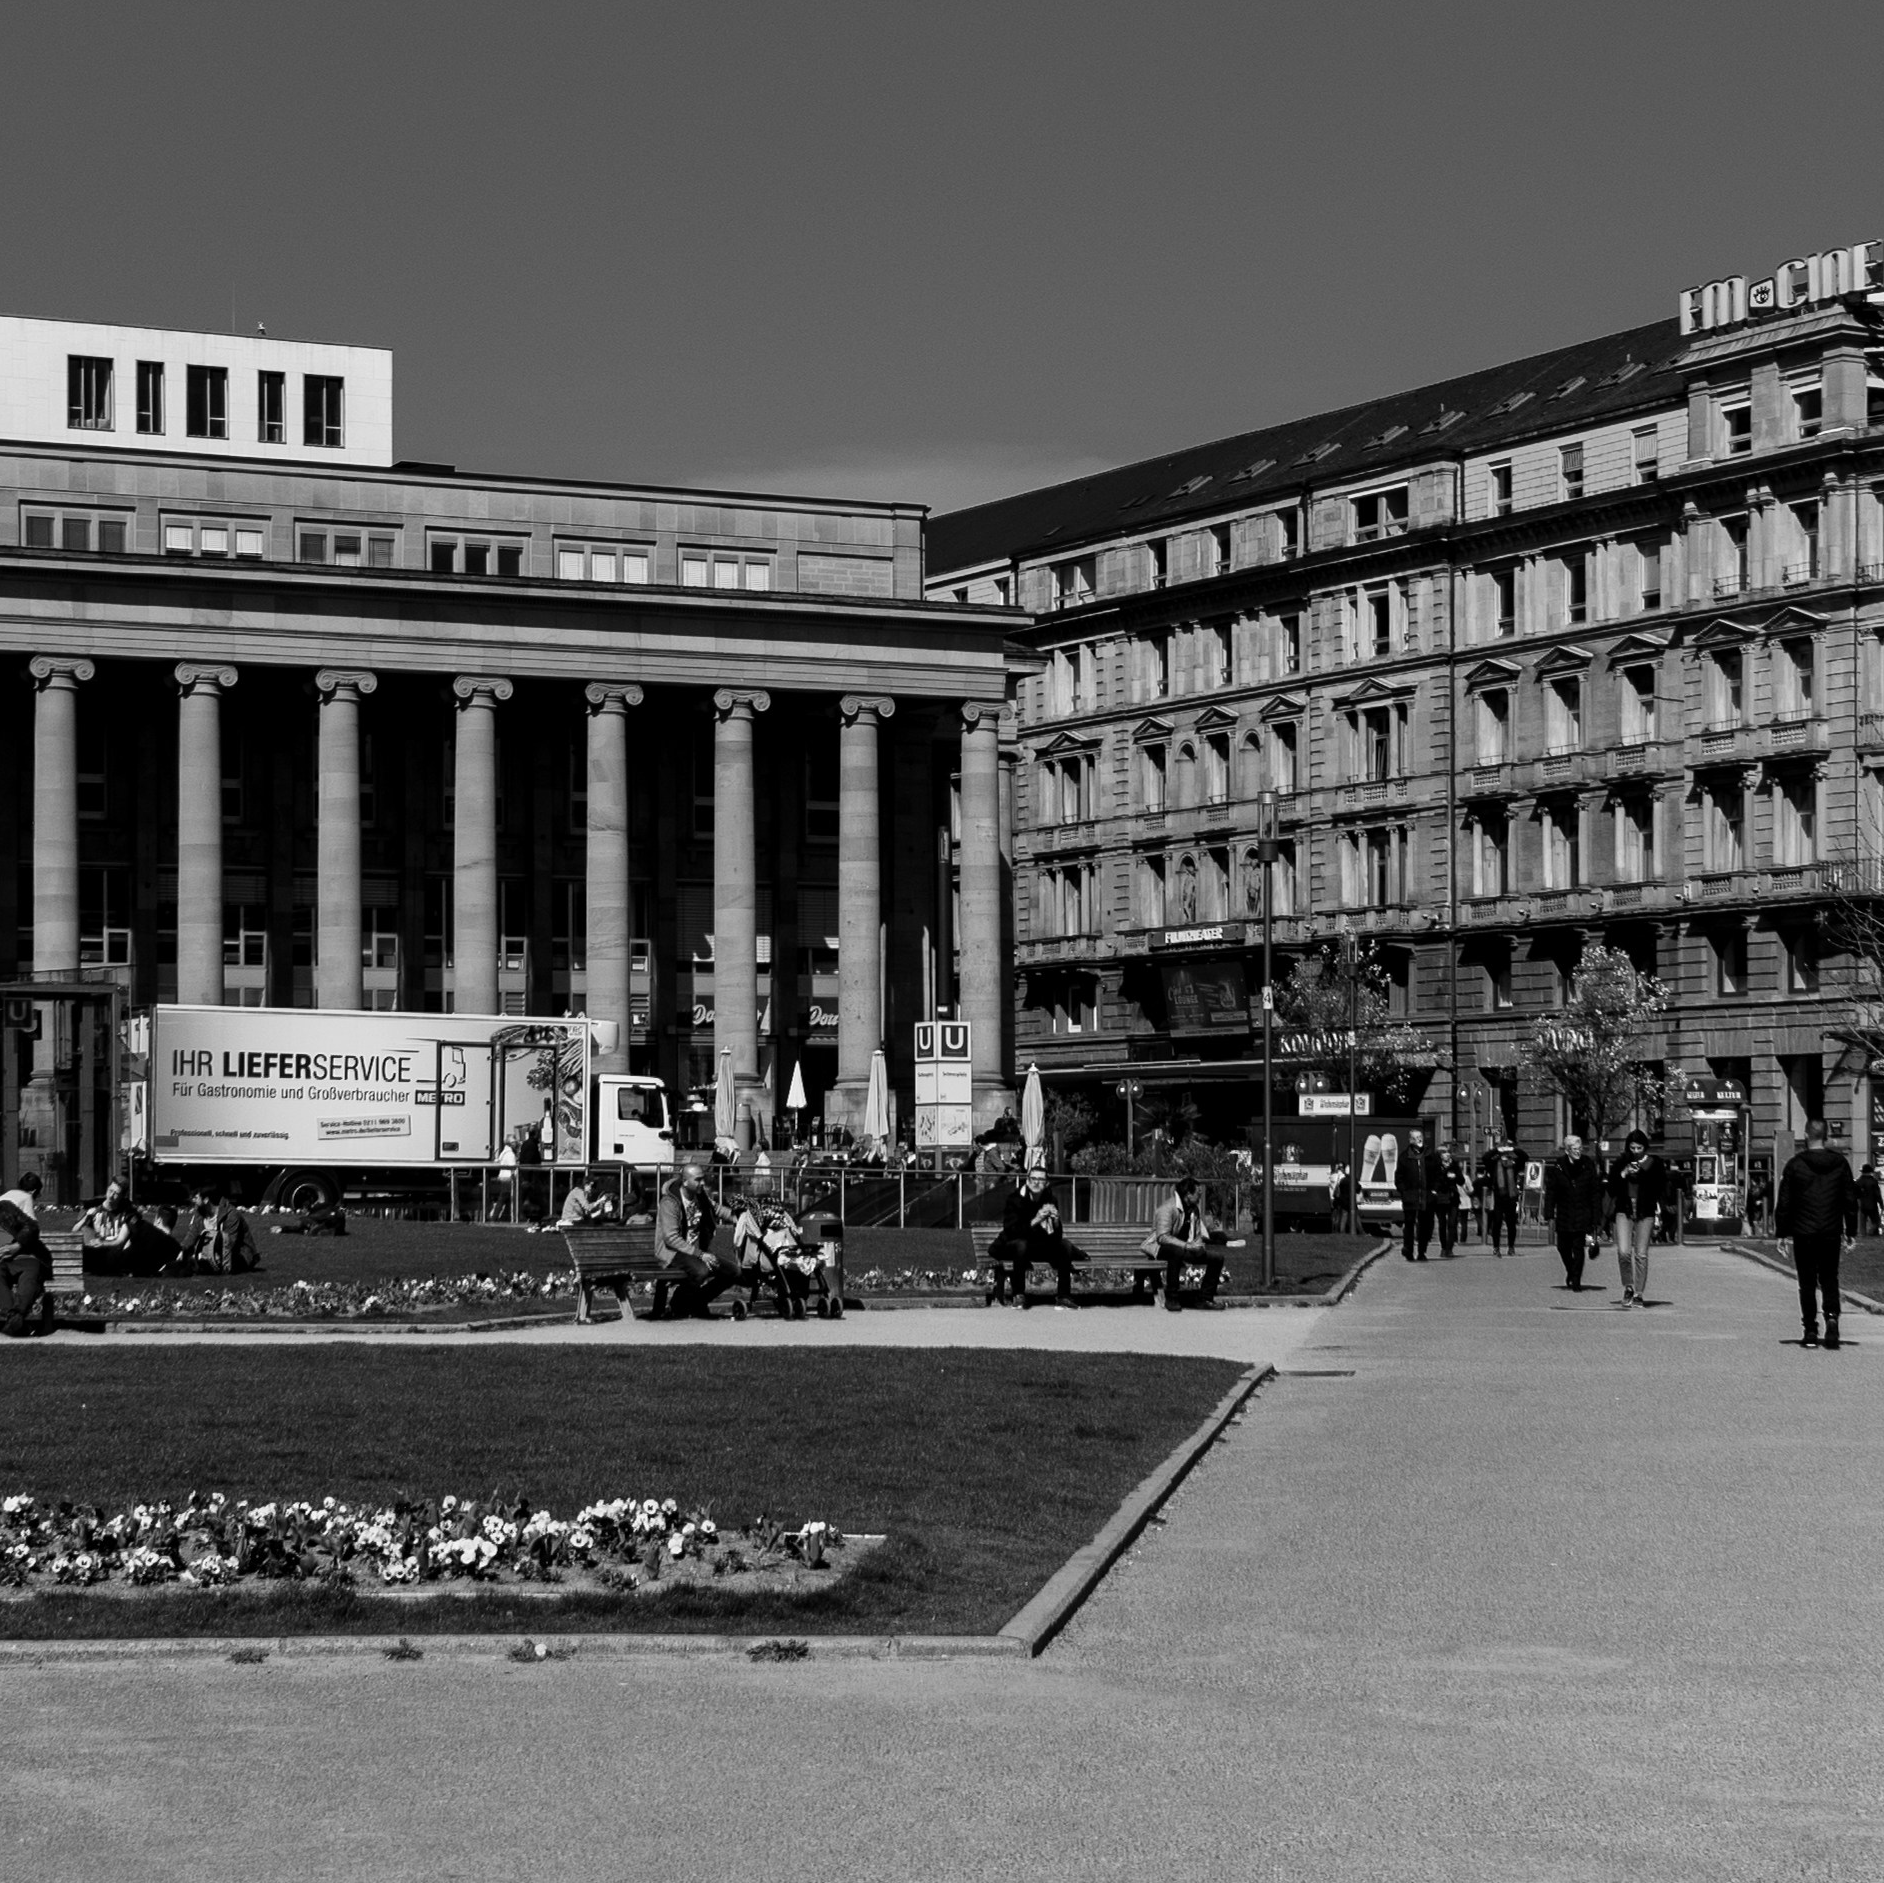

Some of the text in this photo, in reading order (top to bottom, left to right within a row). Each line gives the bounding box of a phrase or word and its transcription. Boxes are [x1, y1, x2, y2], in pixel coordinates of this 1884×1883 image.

[919, 1026, 931, 1050] U
[945, 1026, 964, 1050] U
[172, 1049, 411, 1083] IHR LIEFERSERVICE
[173, 1082, 410, 1103] Für Gastronomie und Großverbraucher
[417, 1092, 464, 1104] MERO
